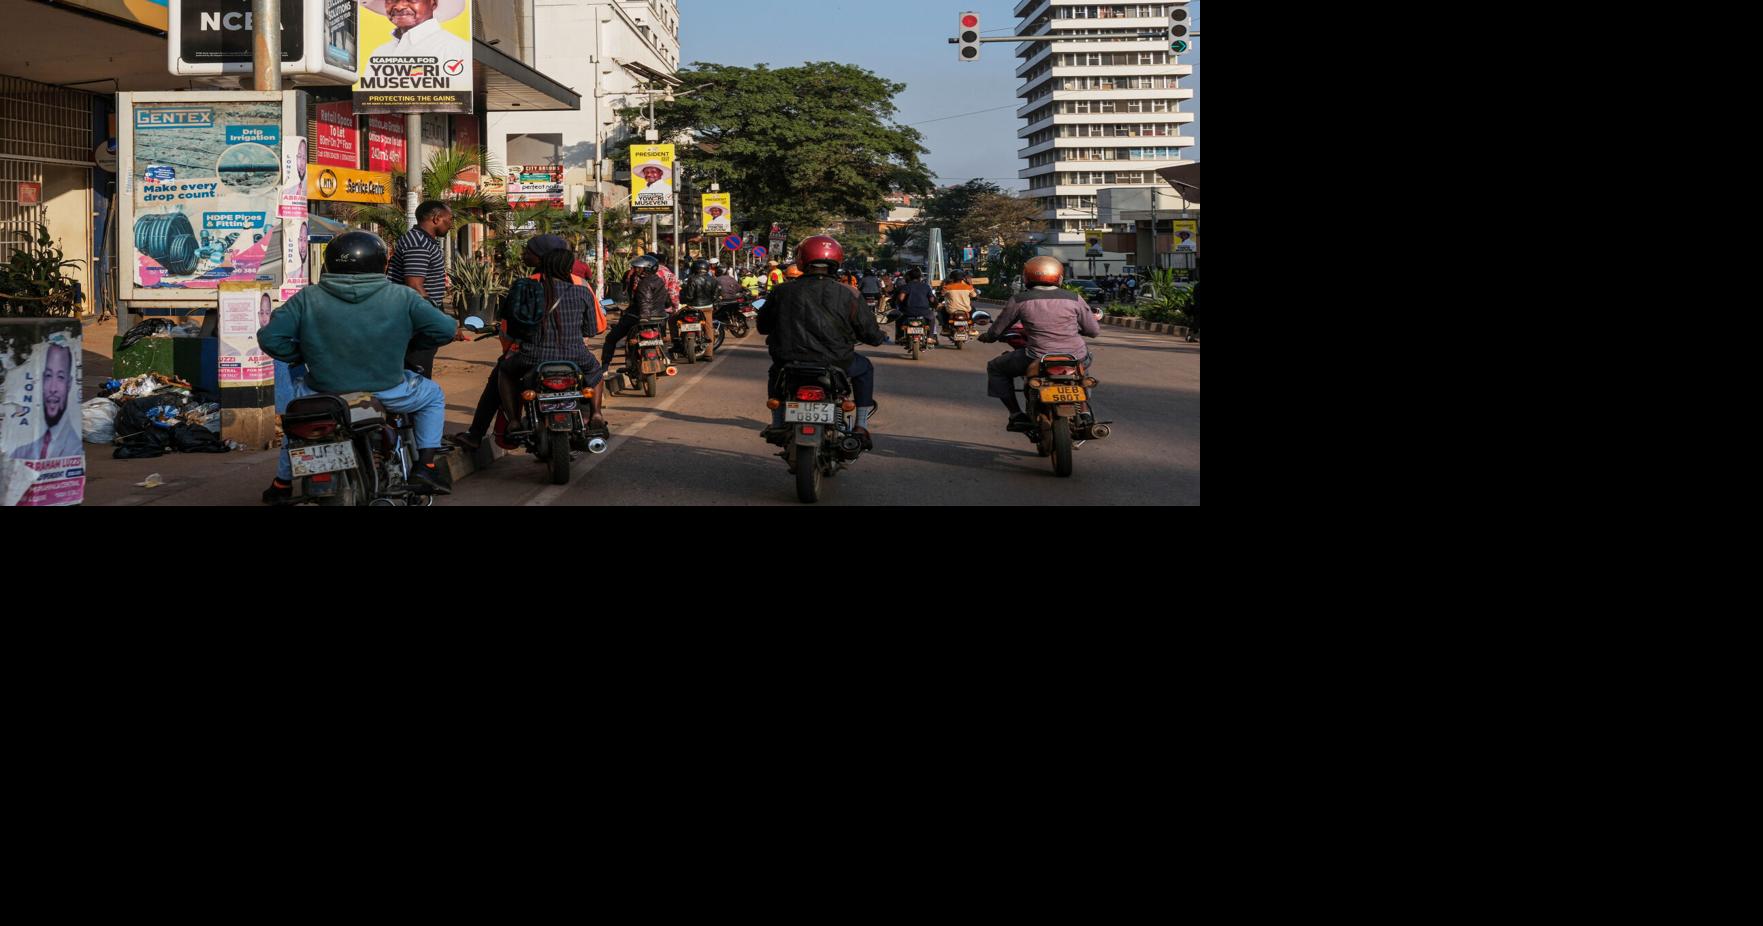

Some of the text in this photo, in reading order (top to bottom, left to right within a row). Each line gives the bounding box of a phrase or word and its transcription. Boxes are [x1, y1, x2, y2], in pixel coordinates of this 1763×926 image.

[200, 11, 284, 31] NC
[360, 77, 450, 88] MUSEVENI
[137, 109, 212, 124] GENTEX
[242, 128, 263, 136] Drip
[329, 125, 345, 138] To Let
[144, 182, 218, 192] Make every
[144, 193, 174, 201] drop
[215, 220, 255, 228] Fittings
[19, 372, 33, 425] LONDA
[804, 402, 829, 412] UFZ
